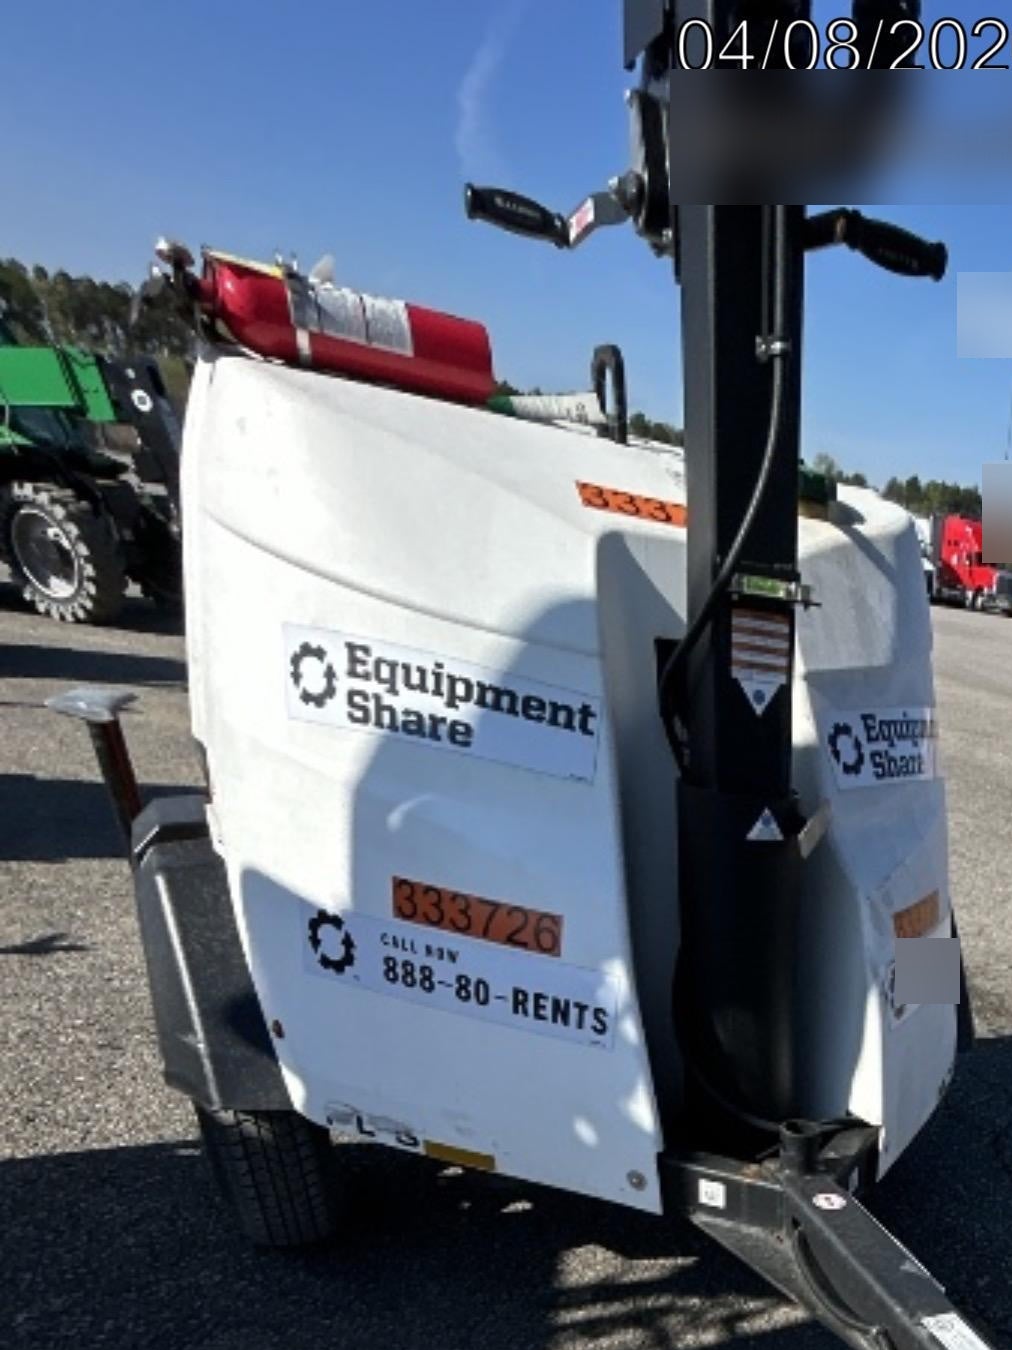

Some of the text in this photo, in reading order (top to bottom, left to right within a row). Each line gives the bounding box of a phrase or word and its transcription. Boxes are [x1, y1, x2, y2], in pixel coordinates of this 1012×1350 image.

[344, 642, 597, 736] Equipment
[346, 689, 473, 748] Share
[380, 932, 418, 955] CALL
[396, 879, 561, 954] 333726
[382, 955, 609, 1036] 888-80-RENTS
